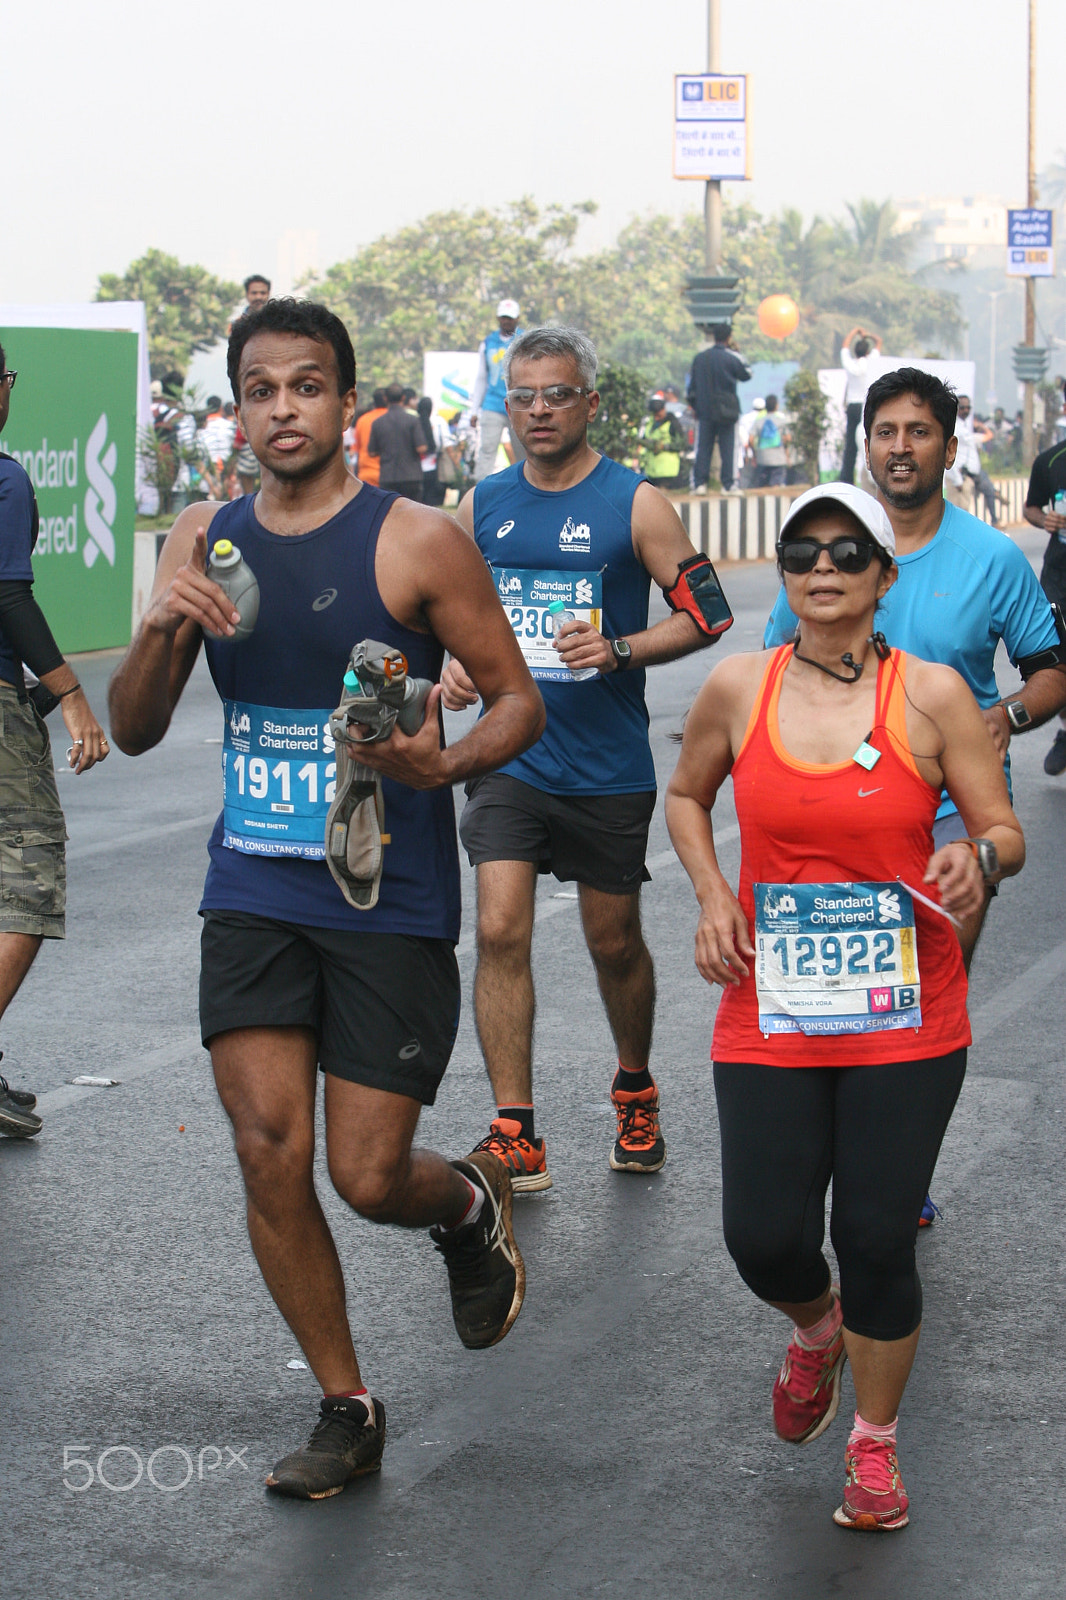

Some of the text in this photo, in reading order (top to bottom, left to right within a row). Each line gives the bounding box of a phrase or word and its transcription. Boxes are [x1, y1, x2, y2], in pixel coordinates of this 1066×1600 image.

[708, 83, 736, 100] LIC
[533, 579, 572, 591] Standard
[530, 590, 572, 602] Chartered
[510, 608, 575, 639] 230
[531, 671, 560, 679] ULTANCY
[263, 720, 318, 736] Standard
[259, 735, 318, 750] Chartered
[233, 755, 336, 803] 19112
[266, 823, 289, 831] SHETTY
[244, 841, 303, 855] CONSULTANCY
[814, 895, 873, 910] Standard
[810, 910, 875, 924] Chartered
[771, 932, 896, 976] 12922
[873, 993, 889, 1006] W
[898, 987, 915, 1008] B
[800, 1020, 865, 1031] CONSULTANCY
[866, 1014, 908, 1028] SERVICES
